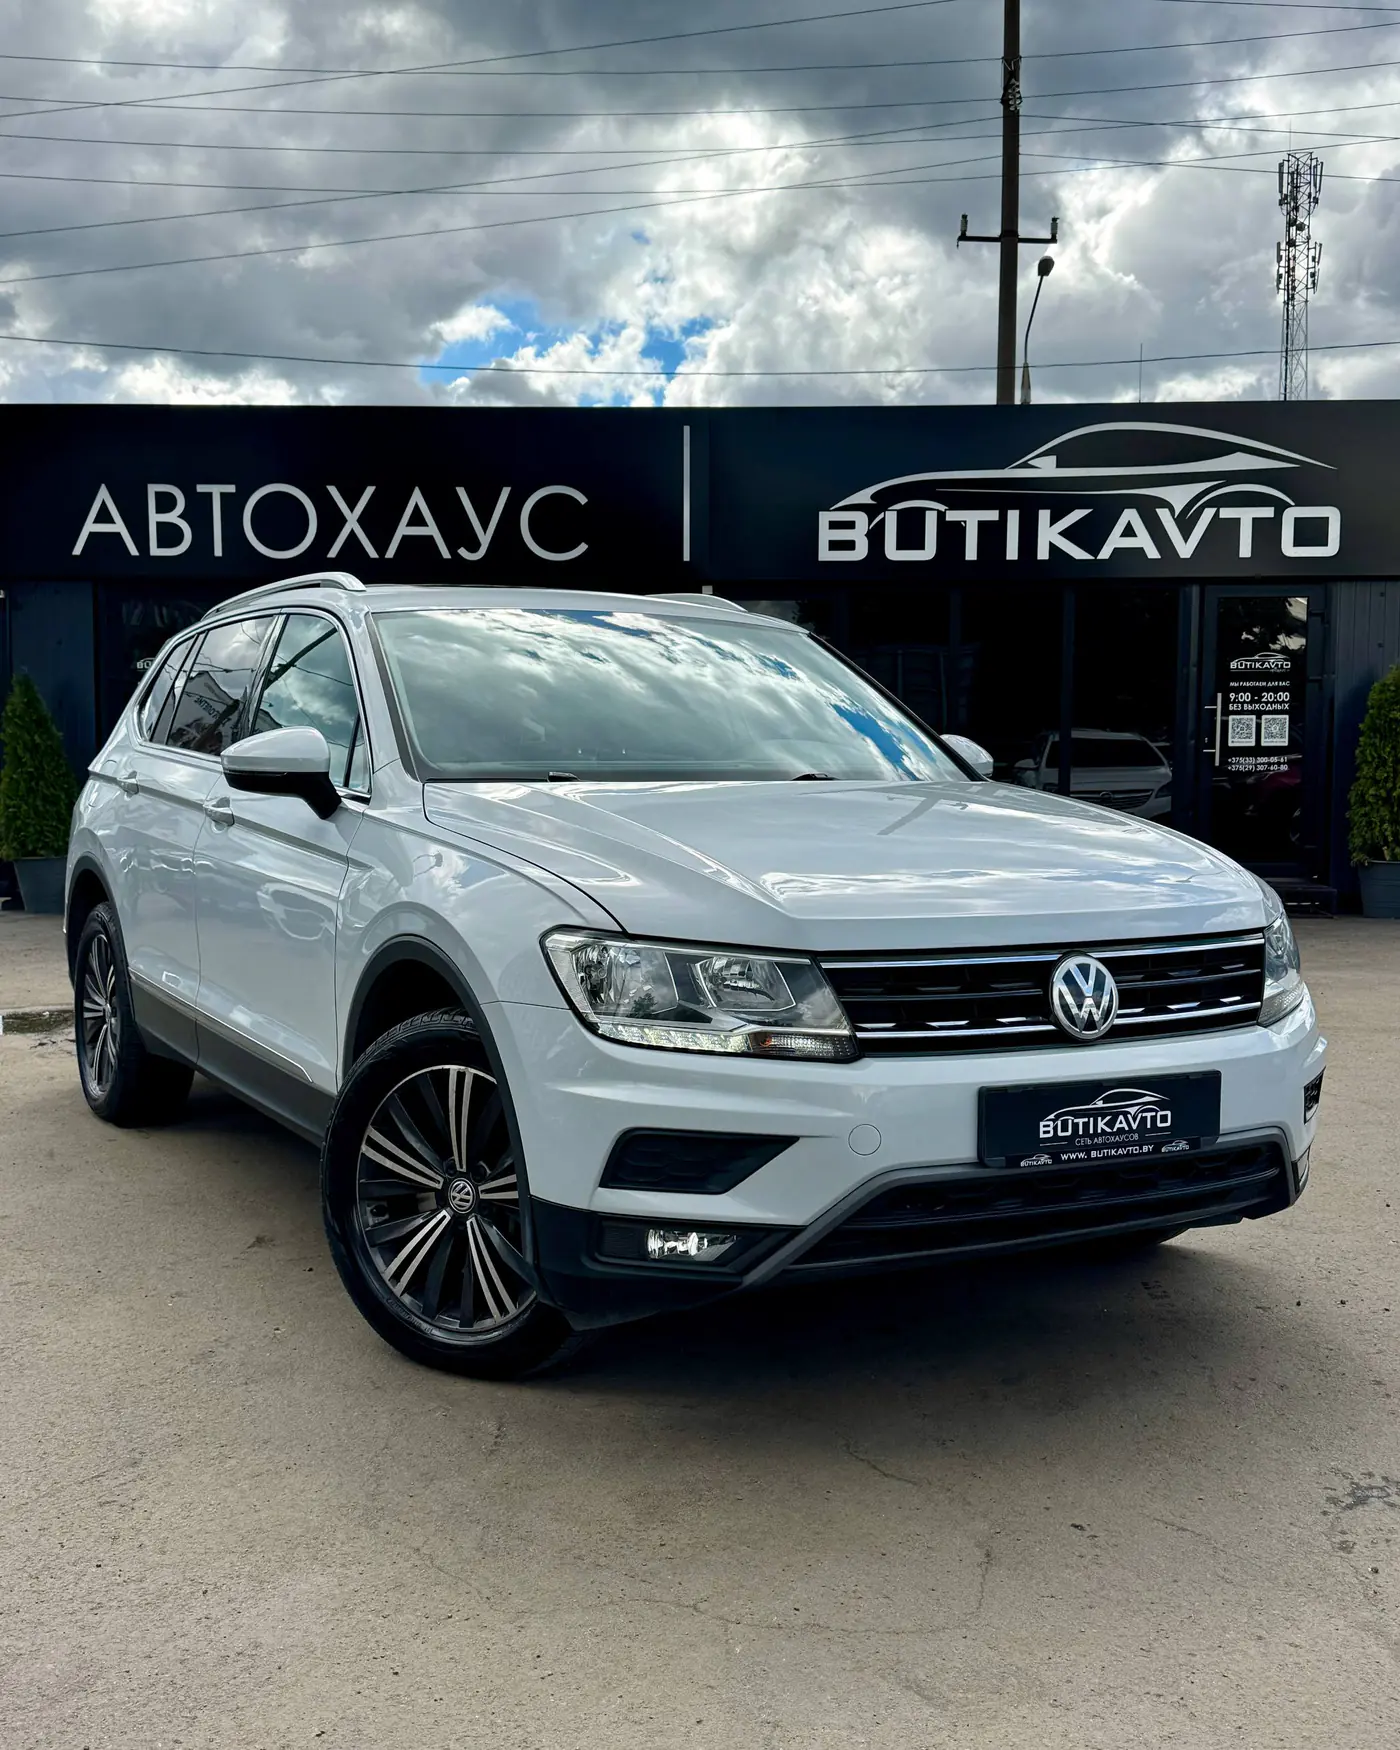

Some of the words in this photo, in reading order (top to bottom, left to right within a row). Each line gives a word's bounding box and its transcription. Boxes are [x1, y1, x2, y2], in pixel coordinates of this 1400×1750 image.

[71, 482, 589, 561] АВТОХАУС
[818, 505, 1341, 562] BUTIKAVTO
[1228, 703, 1242, 711] БЕЗ
[1243, 702, 1290, 711] ВЫХОДНЫХ
[1229, 692, 1251, 702] 9:00
[1261, 691, 1290, 702] 20:00
[1039, 1110, 1172, 1139] BUTIKAVTO
[1075, 1136, 1093, 1146] СЕТЬ
[1093, 1132, 1139, 1144] АВТОХАУСОВ
